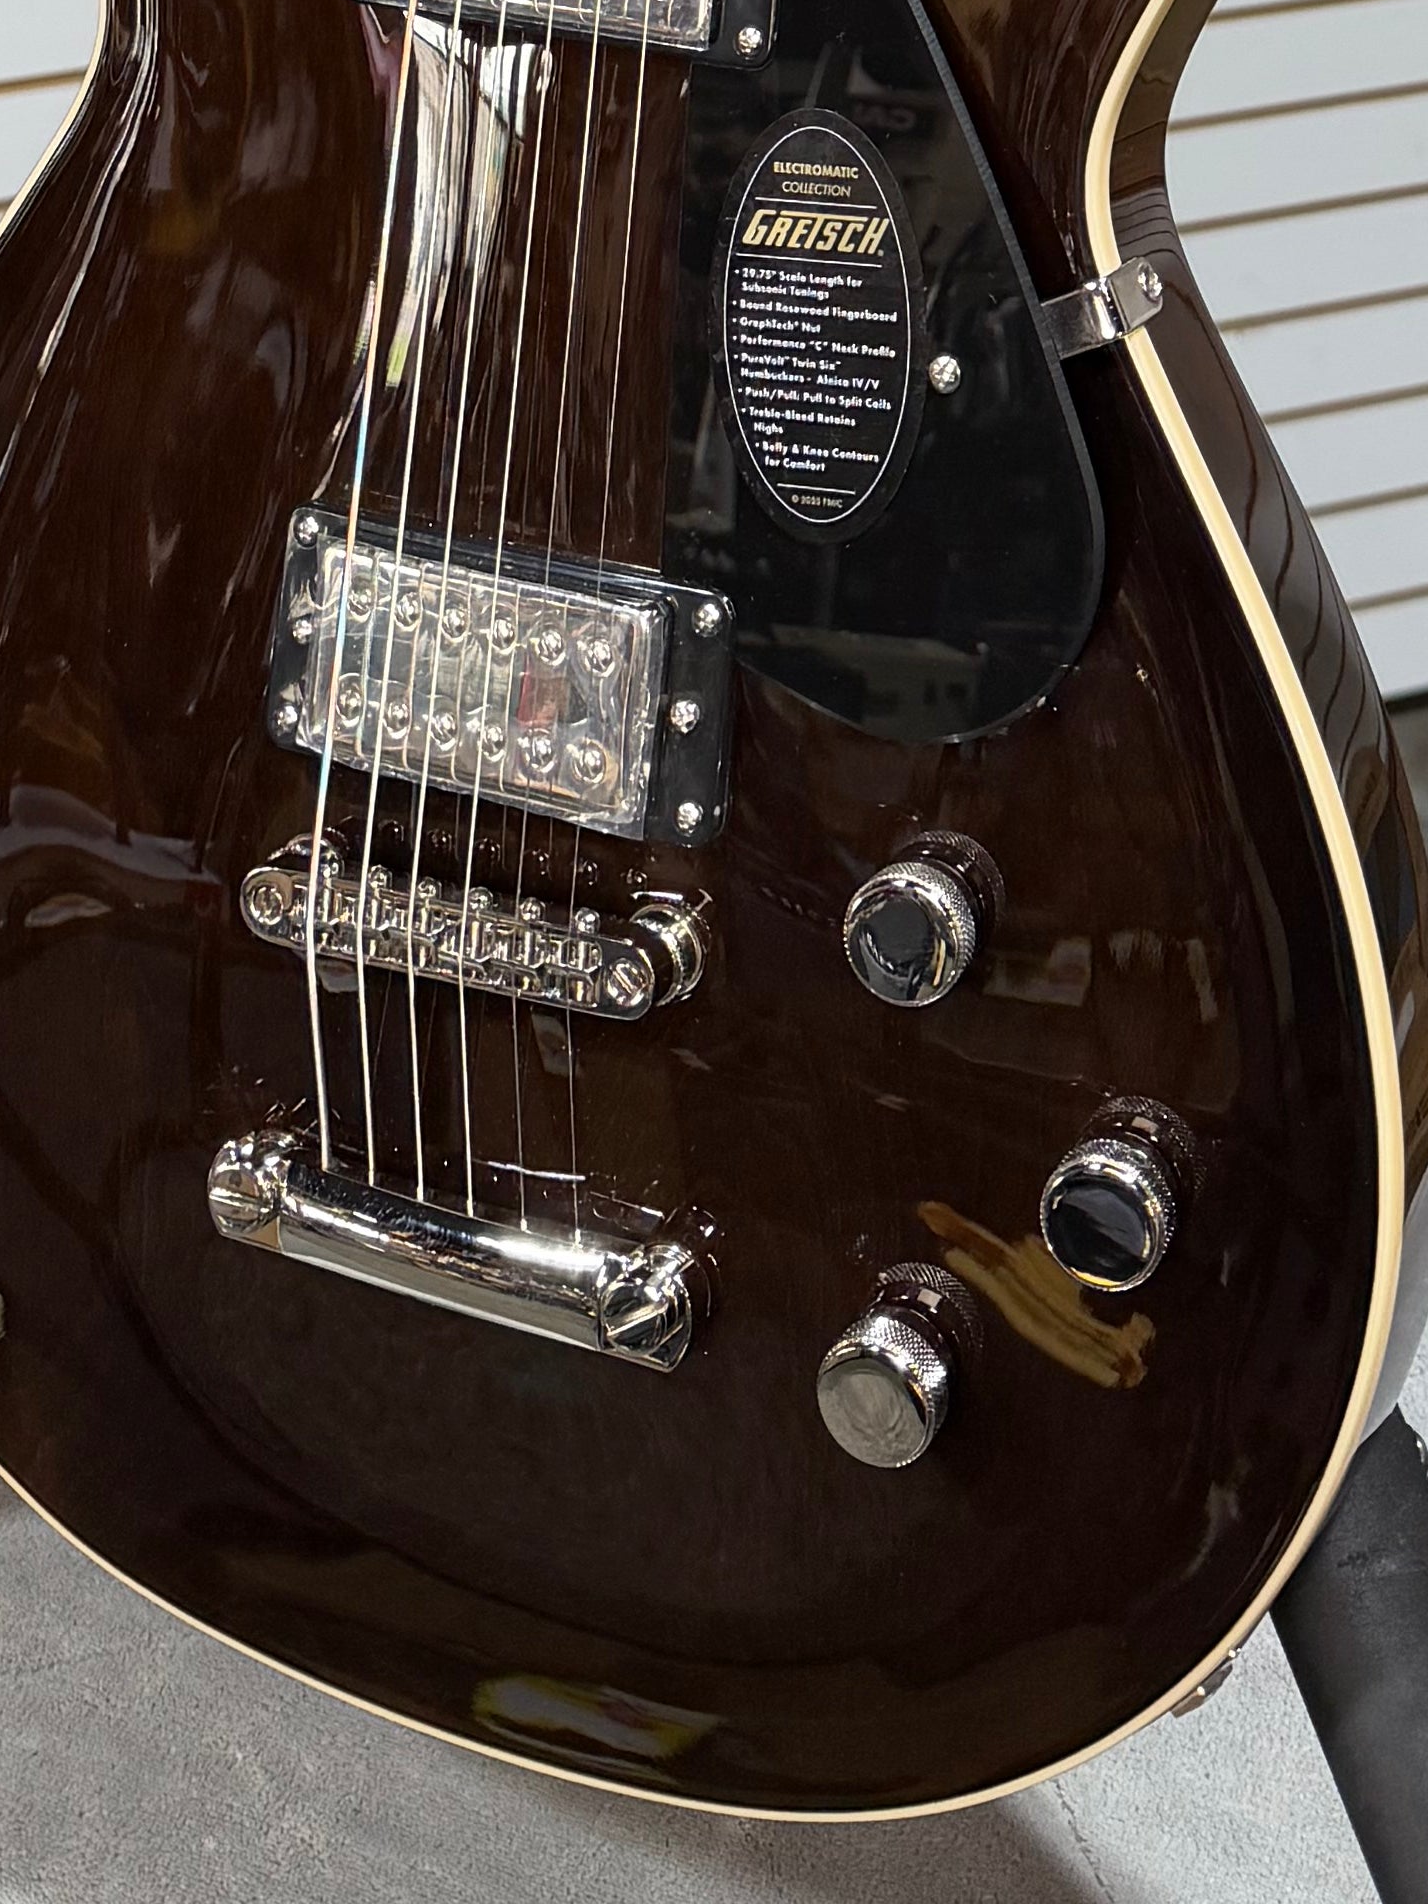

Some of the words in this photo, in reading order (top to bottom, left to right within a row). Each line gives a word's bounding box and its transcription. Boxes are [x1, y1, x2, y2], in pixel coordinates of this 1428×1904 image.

[773, 160, 859, 180] ELECTROMATIC
[781, 181, 851, 198] COLLECTION
[741, 208, 890, 255] GRETSCH
[809, 273, 845, 288] Length
[846, 275, 863, 288] for
[775, 301, 830, 317] Rosewood
[832, 306, 898, 323] Fingerboard
[740, 334, 807, 350] Performance
[831, 342, 859, 355] Neck
[791, 356, 817, 369] Twin
[740, 367, 805, 383] Humbuckers
[802, 391, 823, 404] Pull
[824, 395, 837, 405] to
[838, 395, 863, 409] Split
[764, 455, 781, 467] for
[782, 457, 826, 472] Comfort
[831, 447, 880, 464] Contours
